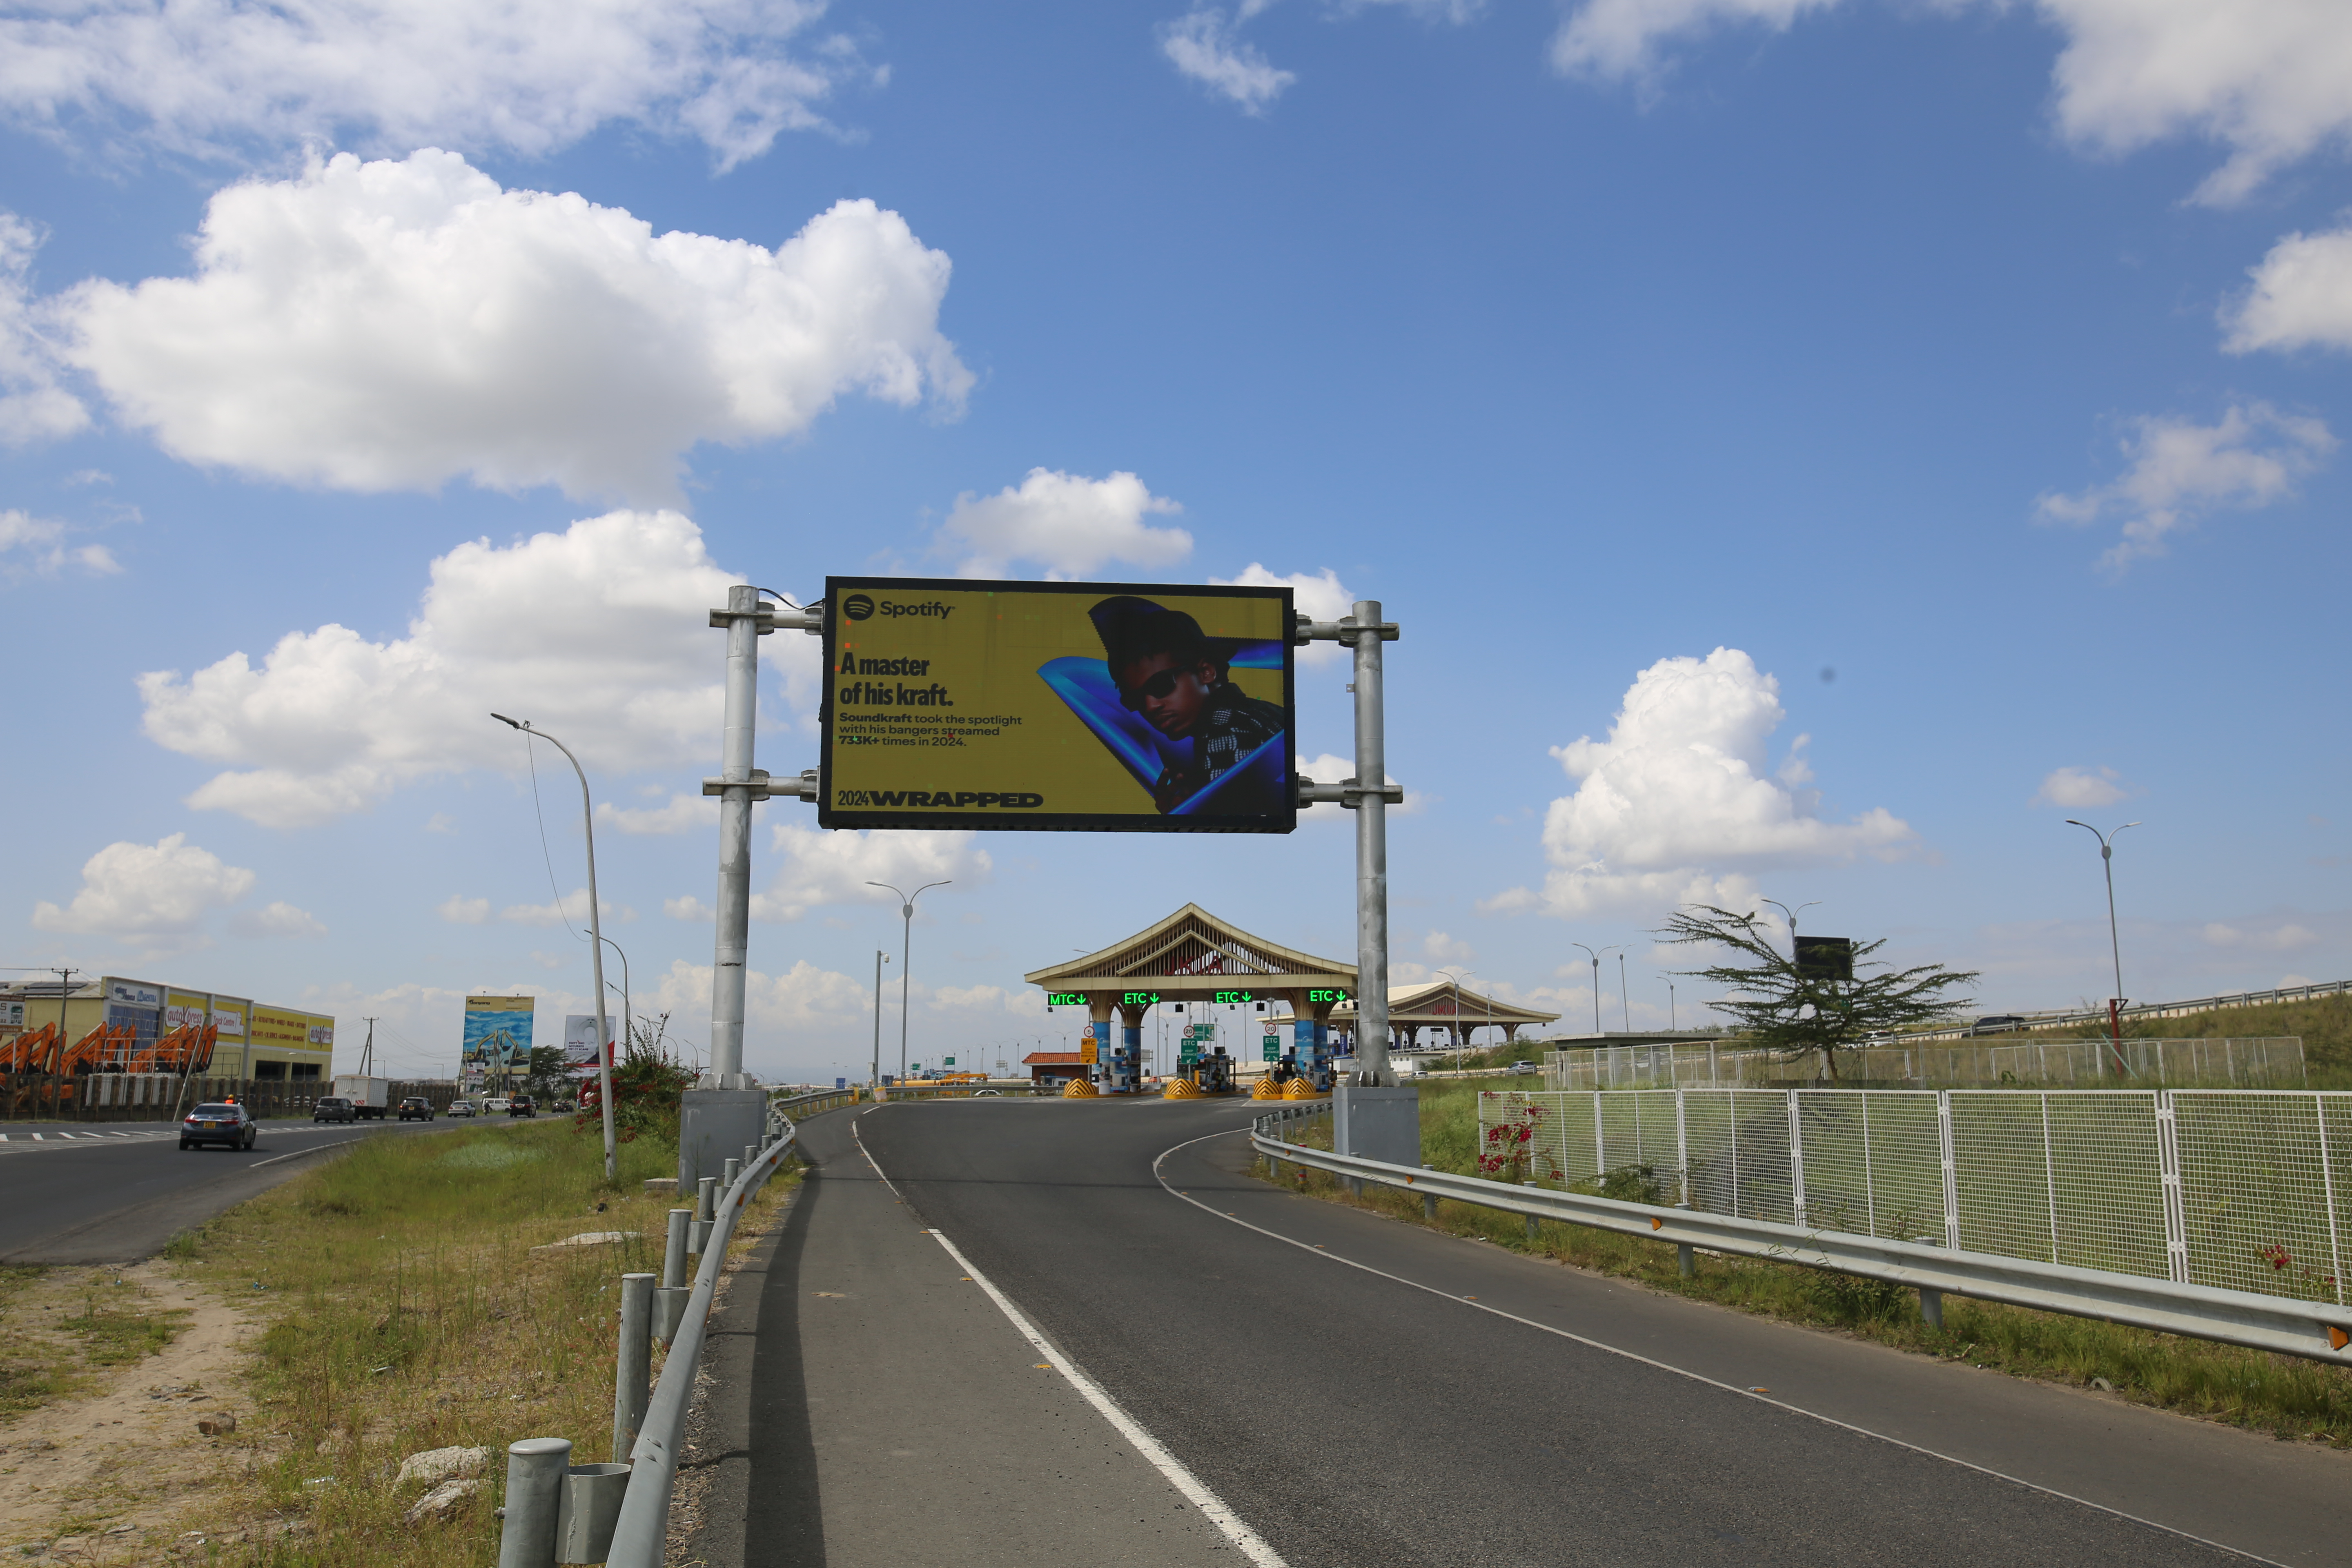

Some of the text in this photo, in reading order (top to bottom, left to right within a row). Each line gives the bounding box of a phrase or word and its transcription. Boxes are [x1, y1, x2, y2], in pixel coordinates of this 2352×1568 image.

[880, 601, 952, 619] Spotify
[840, 652, 930, 676] A master
[840, 682, 953, 706] of his kraft.
[839, 712, 1022, 726] Soundkraft took the spotlight
[839, 724, 1000, 736] with his bangers streamed
[839, 735, 967, 746] 733K+ times in 2024.
[838, 790, 1044, 808] 2024 WRAPPED
[1164, 956, 1224, 976] JKIA
[1050, 994, 1075, 1005] MTC
[1125, 993, 1147, 1004] ETC
[1216, 992, 1238, 1003] ETC
[1310, 990, 1333, 1001] ETC
